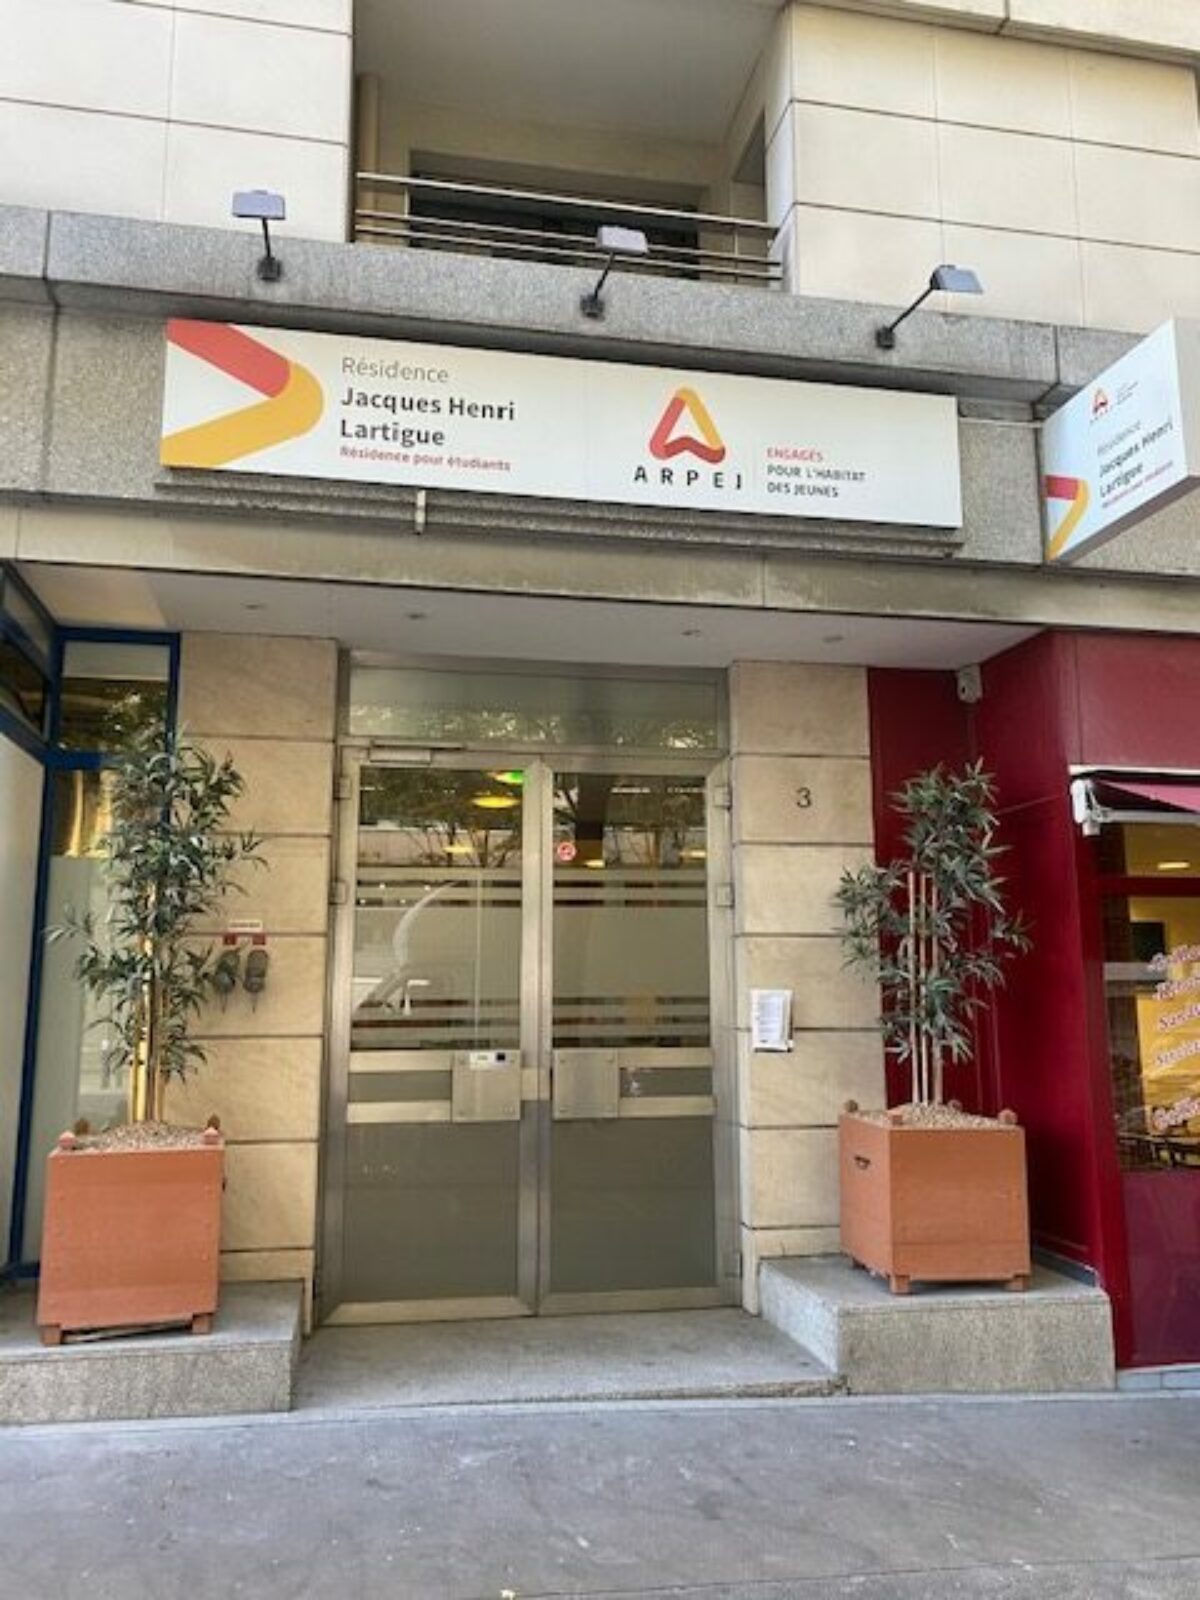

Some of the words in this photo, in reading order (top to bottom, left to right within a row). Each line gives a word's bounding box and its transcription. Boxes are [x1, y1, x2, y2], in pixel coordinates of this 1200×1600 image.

[341, 357, 449, 384] Résidence
[340, 387, 442, 415] Jacques
[448, 396, 516, 421] Henri
[340, 419, 446, 448] Lartigue
[1099, 443, 1140, 478] Jacques
[1141, 415, 1174, 448] Henri
[340, 446, 410, 463] Résidence
[412, 453, 443, 466] pour
[447, 456, 512, 471] étudiants
[633, 465, 742, 490] ARPEJ
[767, 464, 801, 478] POUR
[806, 467, 866, 481] L'HABITAT
[1099, 462, 1143, 498] Lartigue
[767, 482, 791, 494] DES
[794, 484, 839, 498] JEUNES
[796, 787, 812, 808] 3
